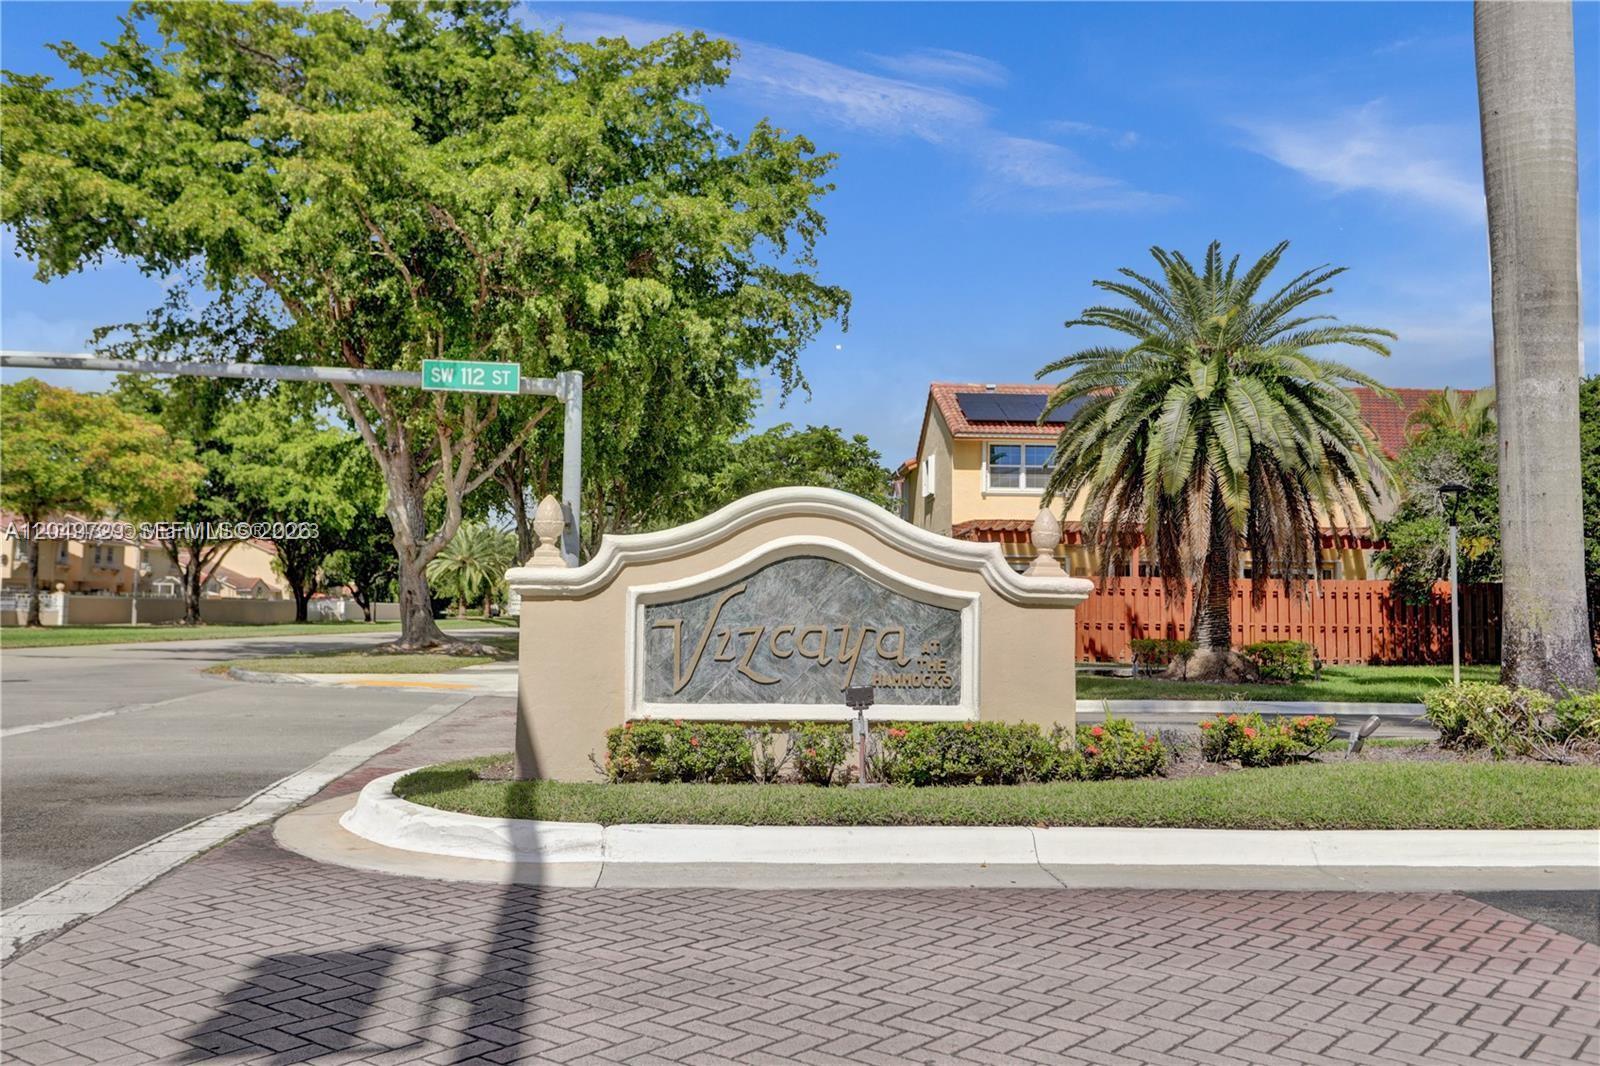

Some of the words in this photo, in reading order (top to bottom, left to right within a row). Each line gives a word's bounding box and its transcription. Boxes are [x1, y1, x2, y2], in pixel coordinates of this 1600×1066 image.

[431, 367, 454, 383] SW
[461, 367, 485, 385] 112
[492, 370, 511, 385] ST
[651, 583, 912, 695] Vizcaya
[920, 639, 941, 656] AT
[916, 658, 947, 674] THE
[871, 672, 953, 690] HAMMOCKS
